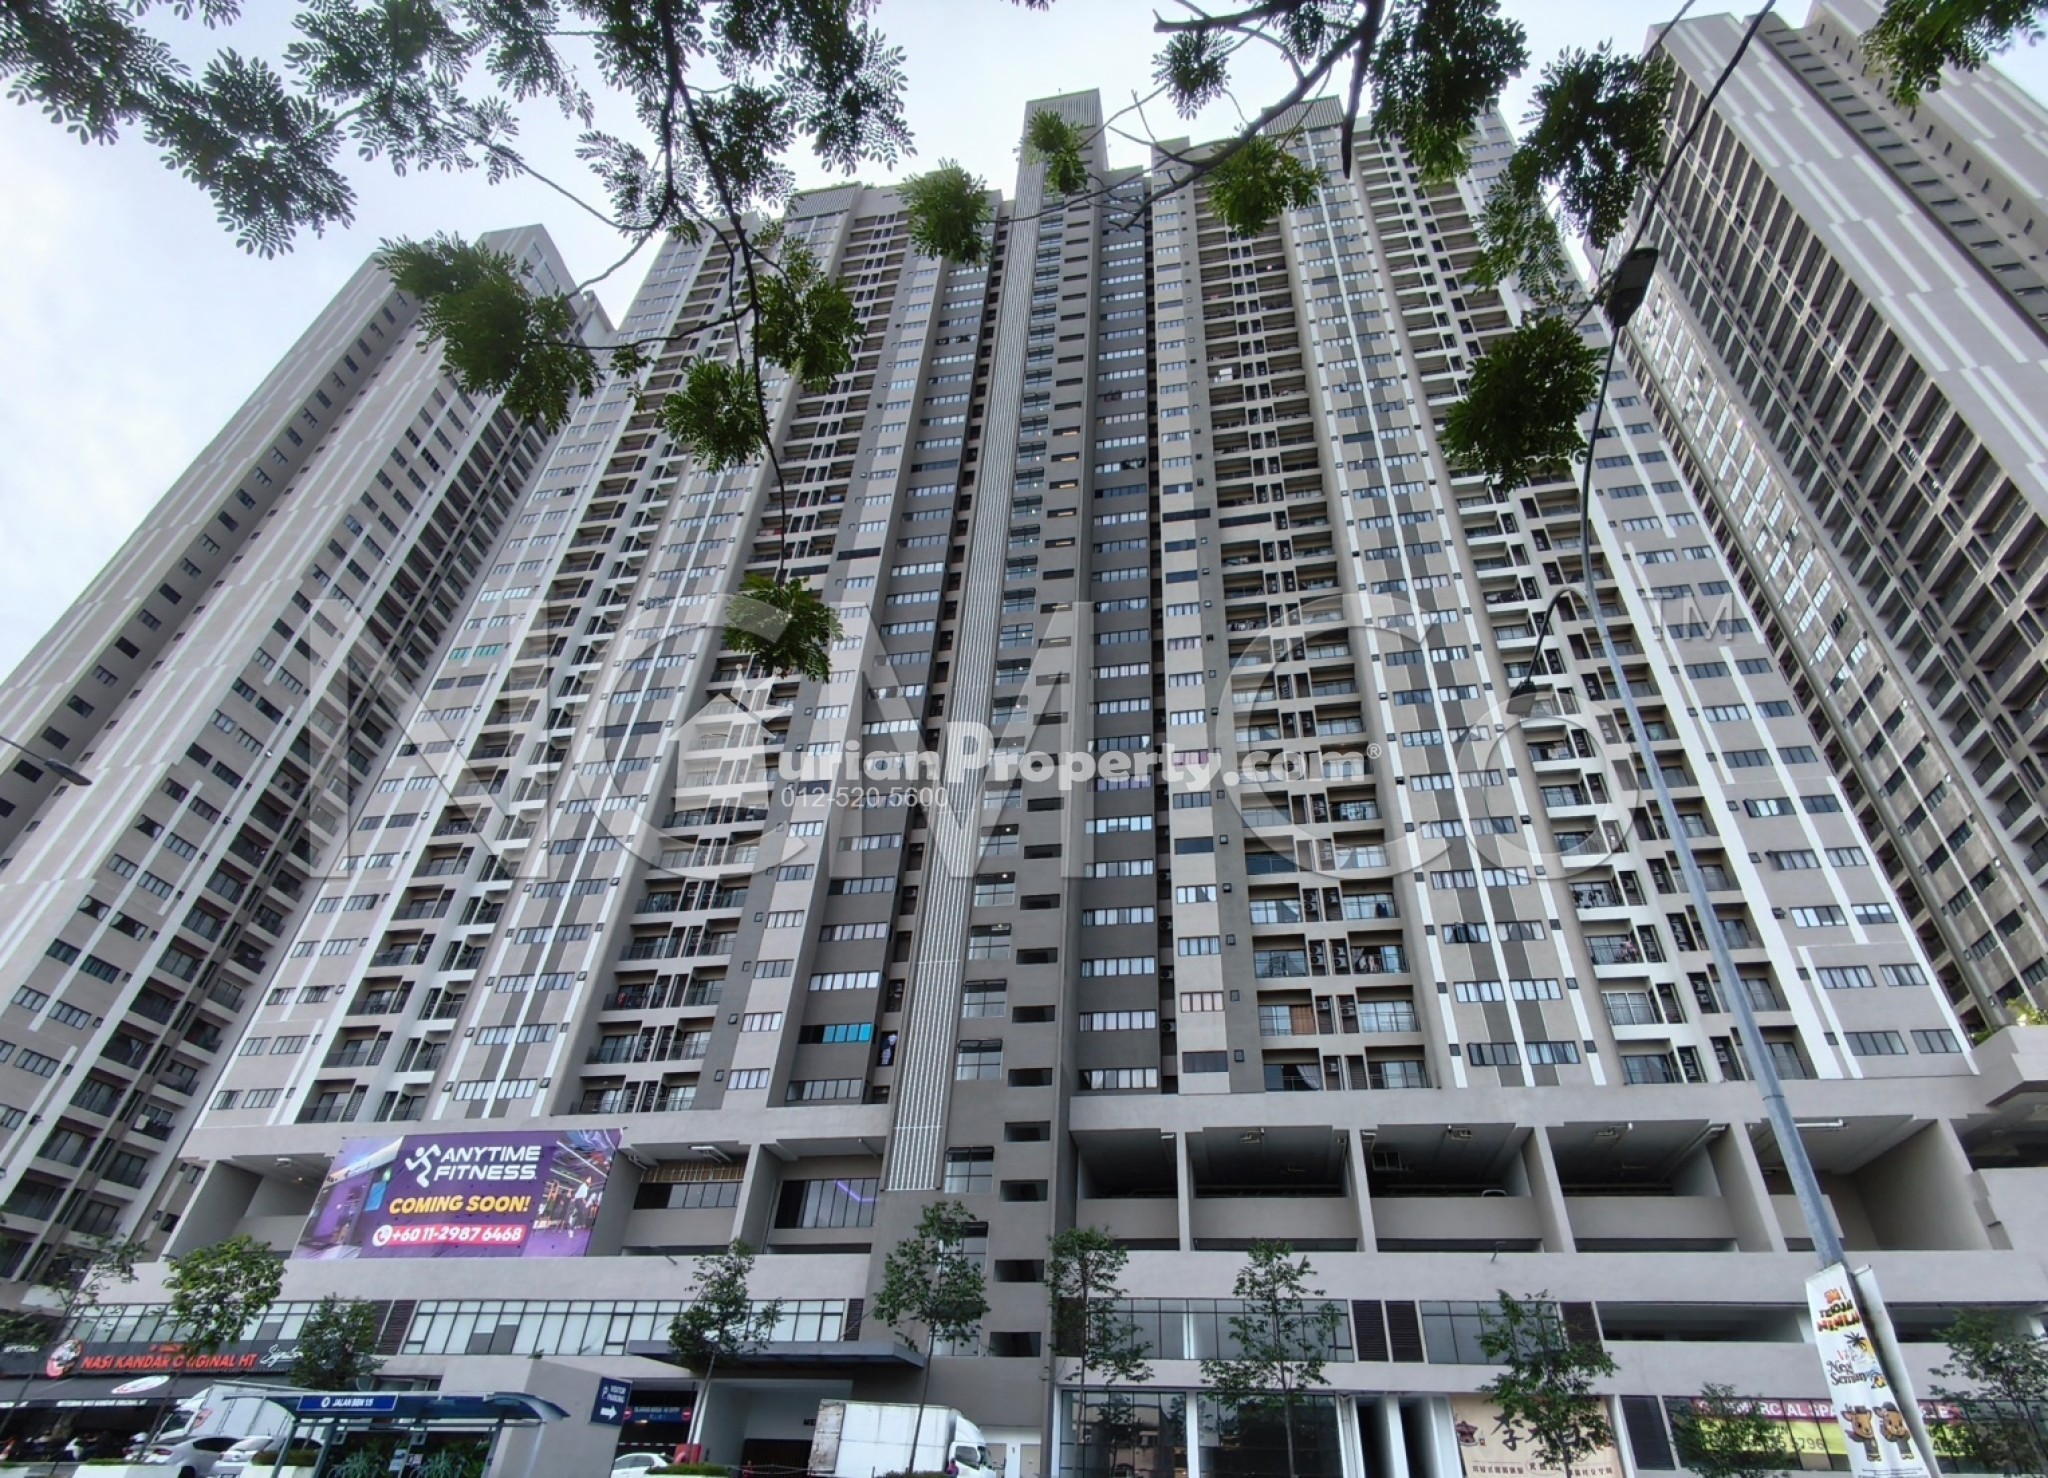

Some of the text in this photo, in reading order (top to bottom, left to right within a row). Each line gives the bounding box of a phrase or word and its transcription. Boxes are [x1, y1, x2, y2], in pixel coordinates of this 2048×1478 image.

[440, 1145, 542, 1163] ANYTIME
[433, 1163, 535, 1181] FITNESS
[389, 1195, 531, 1214] COMING SOON!
[392, 1225, 522, 1242] +60 11-2987 6468
[81, 1355, 115, 1369] NASI
[238, 1353, 258, 1368] HT
